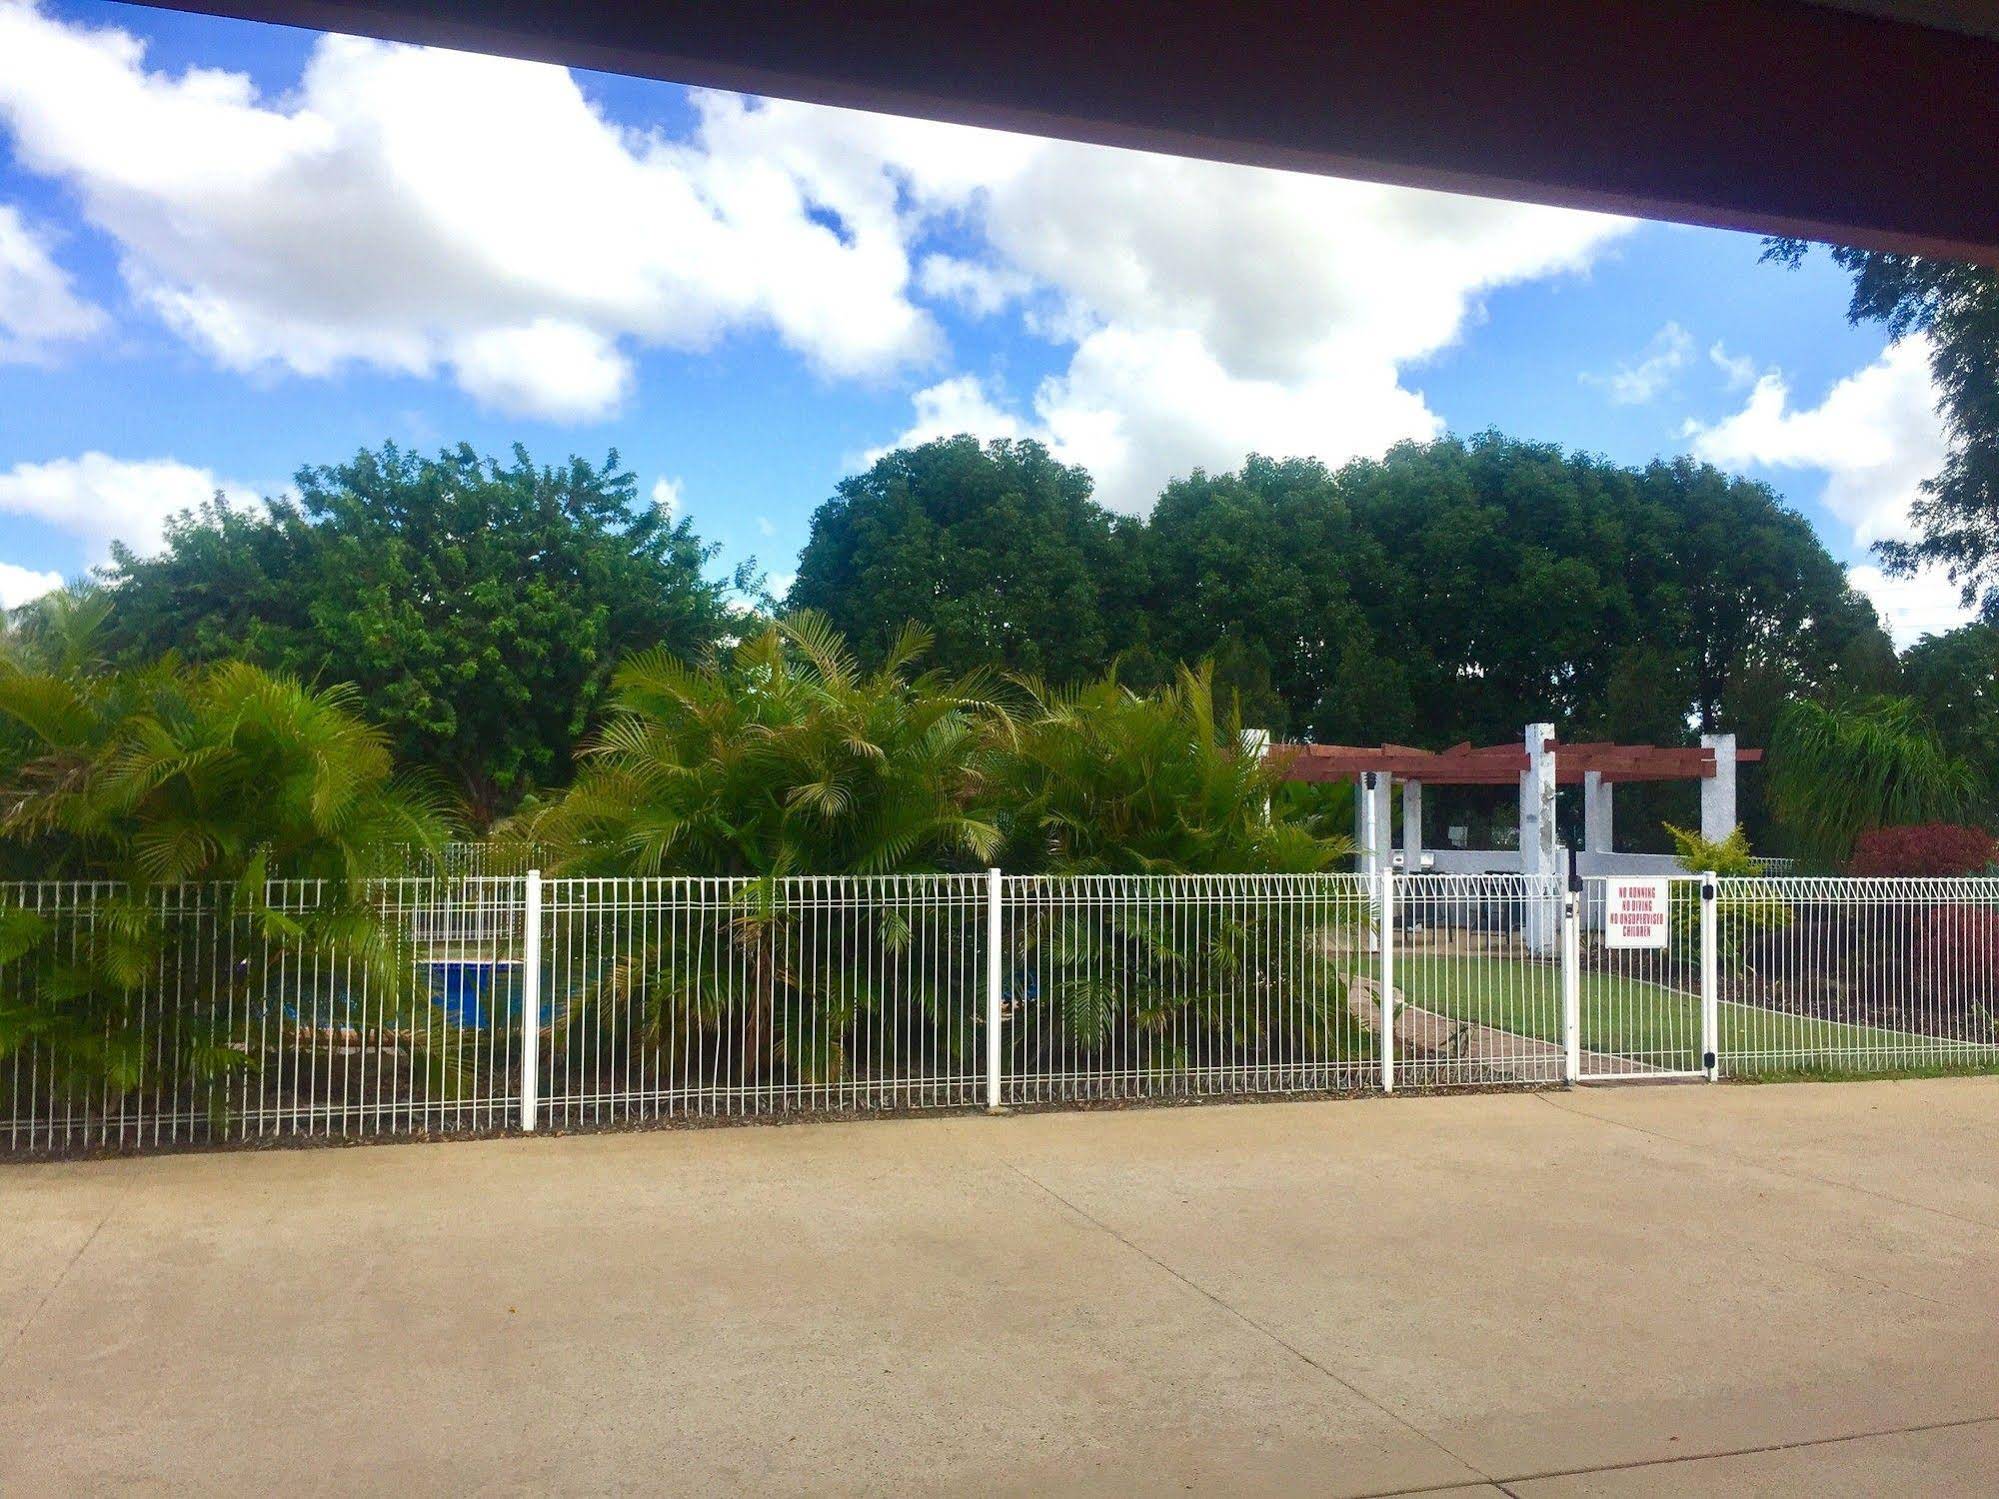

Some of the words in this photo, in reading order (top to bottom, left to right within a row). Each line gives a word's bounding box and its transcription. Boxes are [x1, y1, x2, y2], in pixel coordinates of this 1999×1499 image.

[1619, 887, 1627, 898] NO
[1629, 887, 1655, 898] RUNNING
[1623, 900, 1630, 911] NO
[1632, 900, 1652, 911] DIVING
[1610, 913, 1618, 924] NO
[1620, 913, 1663, 924] UNSUPERVISED
[1623, 926, 1651, 937] CHILDREN
